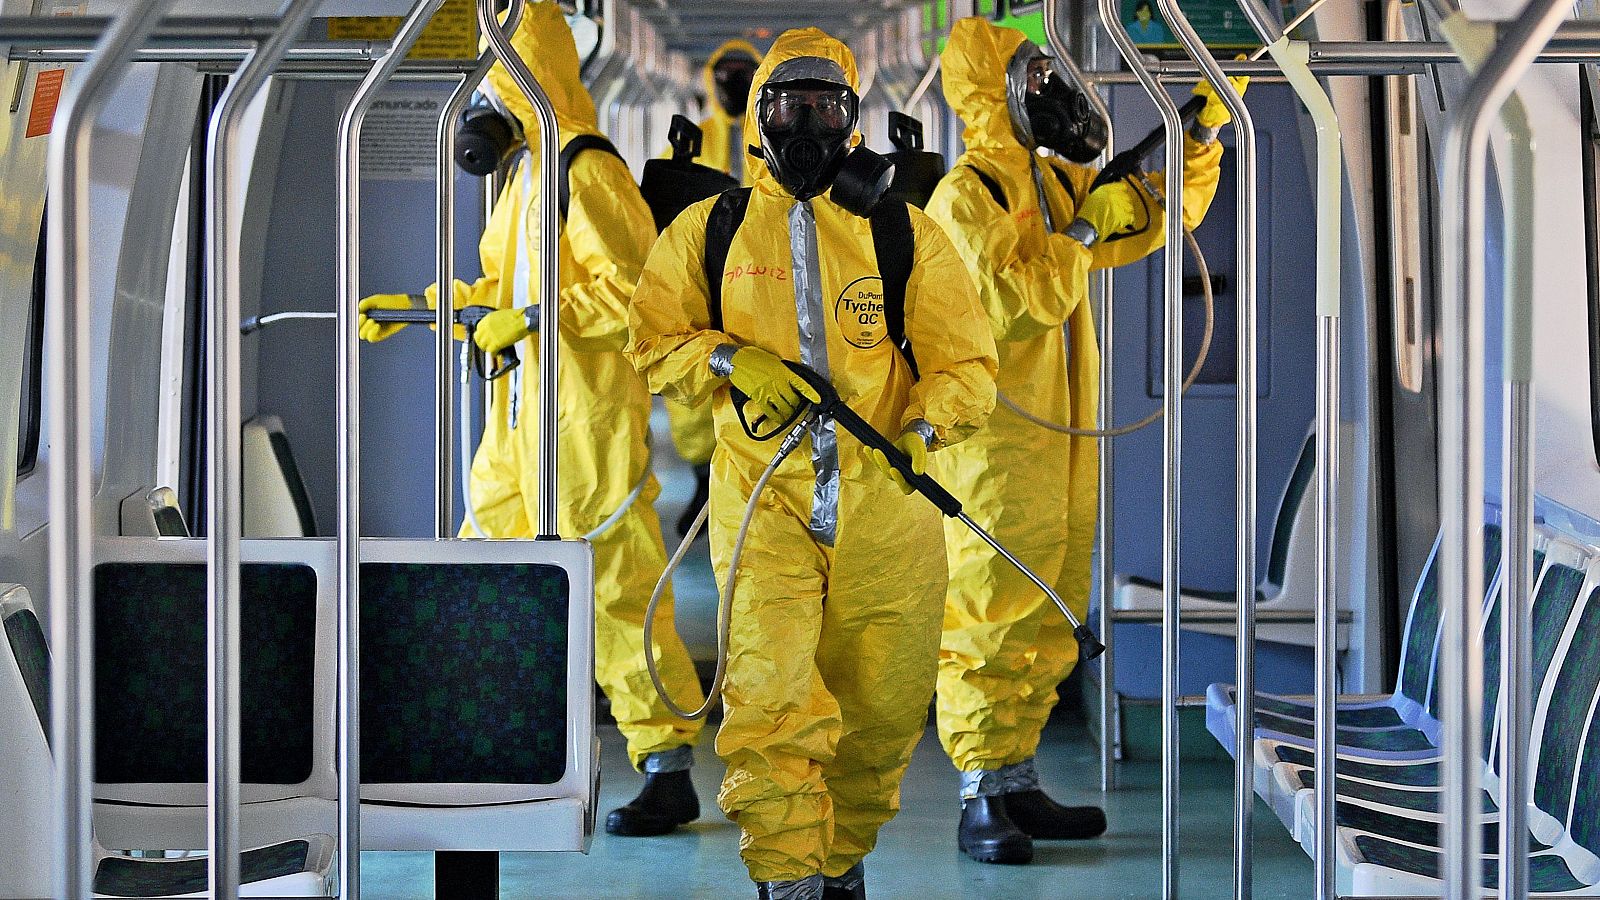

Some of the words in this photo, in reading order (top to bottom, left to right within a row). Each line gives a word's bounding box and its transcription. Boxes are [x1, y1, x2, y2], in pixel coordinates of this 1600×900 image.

[369, 99, 438, 110] omunicado
[746, 263, 786, 280] LUIZ
[843, 298, 884, 314] Tyche
[858, 313, 879, 325] QC
